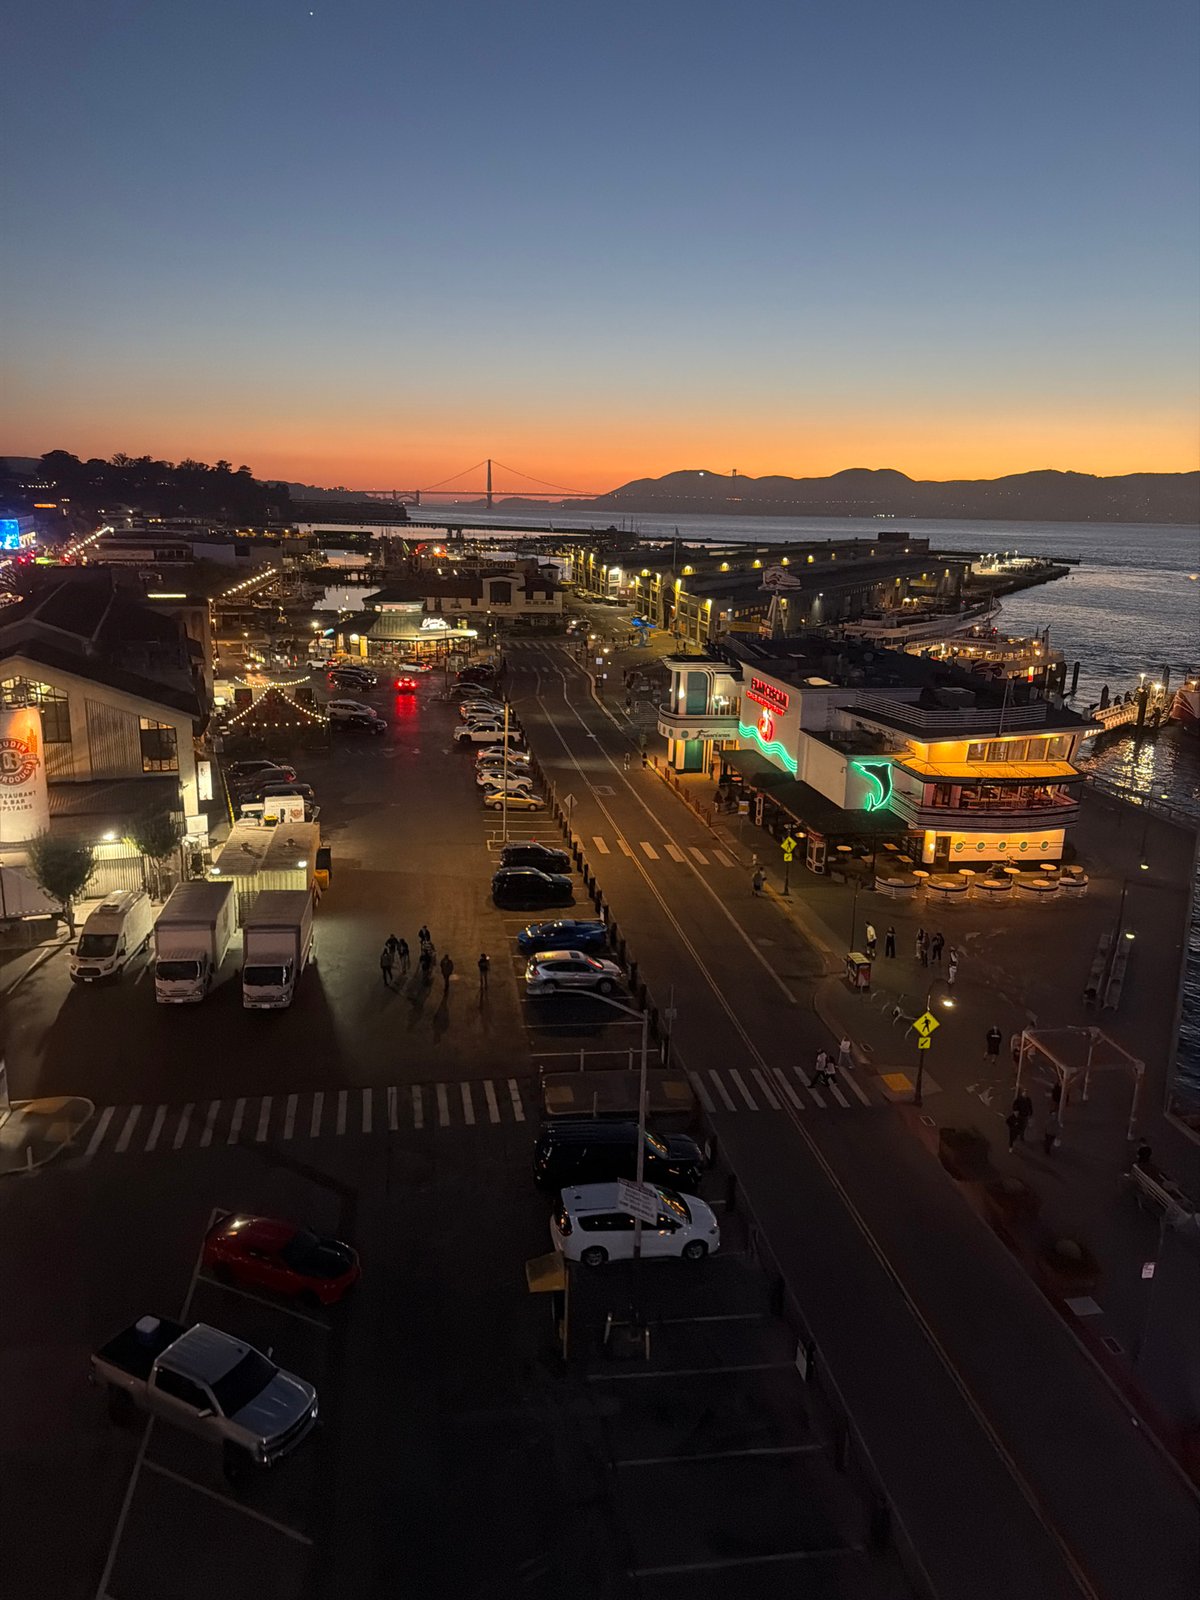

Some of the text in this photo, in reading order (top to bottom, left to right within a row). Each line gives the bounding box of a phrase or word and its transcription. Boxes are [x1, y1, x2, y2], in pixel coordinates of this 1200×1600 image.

[431, 558, 484, 568] Fisherman's
[486, 560, 516, 569] Grotto
[0, 803, 33, 811] PSTAIRS
